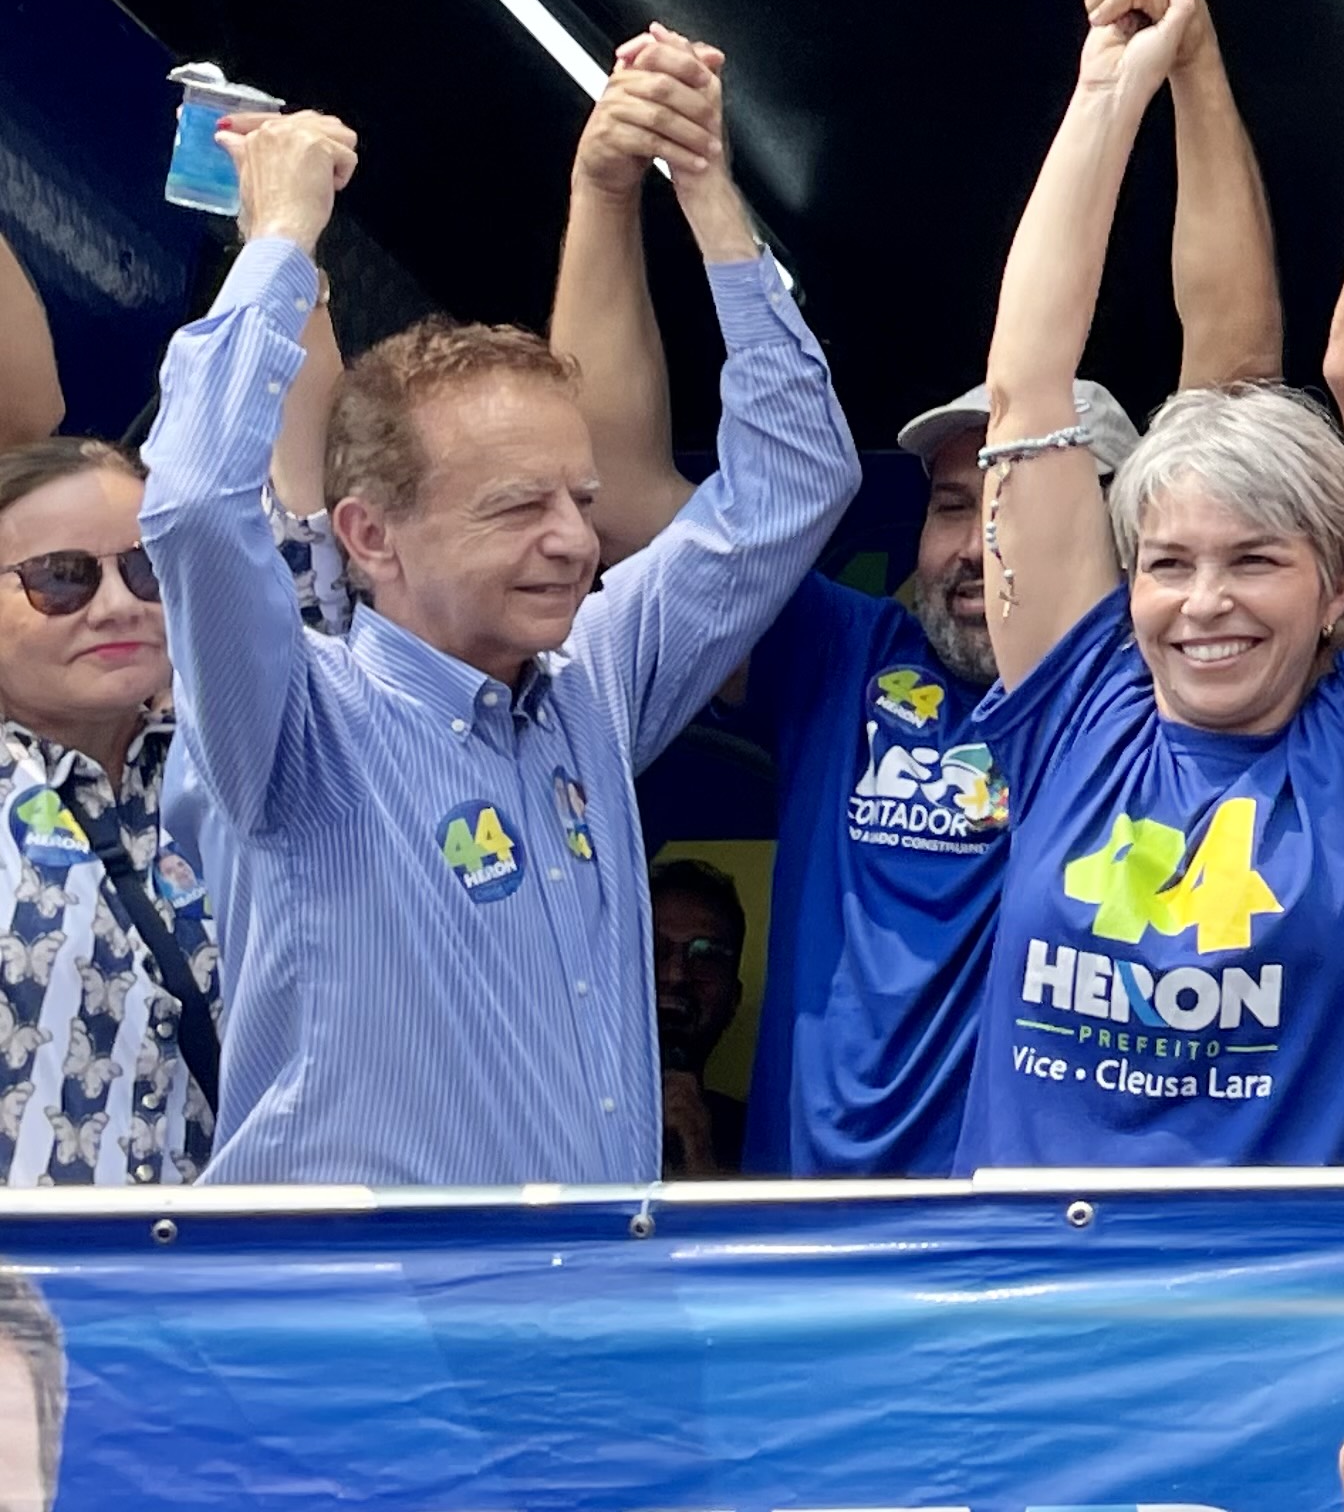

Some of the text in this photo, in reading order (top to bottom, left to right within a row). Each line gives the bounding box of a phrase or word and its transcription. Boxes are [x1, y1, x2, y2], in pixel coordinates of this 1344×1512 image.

[443, 806, 515, 874] 44
[463, 858, 518, 889] HERON
[1064, 797, 1285, 954] 44
[1022, 939, 1283, 1031] HERON
[1013, 1045, 1274, 1100] Vice Cleusa Lara
[1079, 1025, 1221, 1061] PREFEITO
